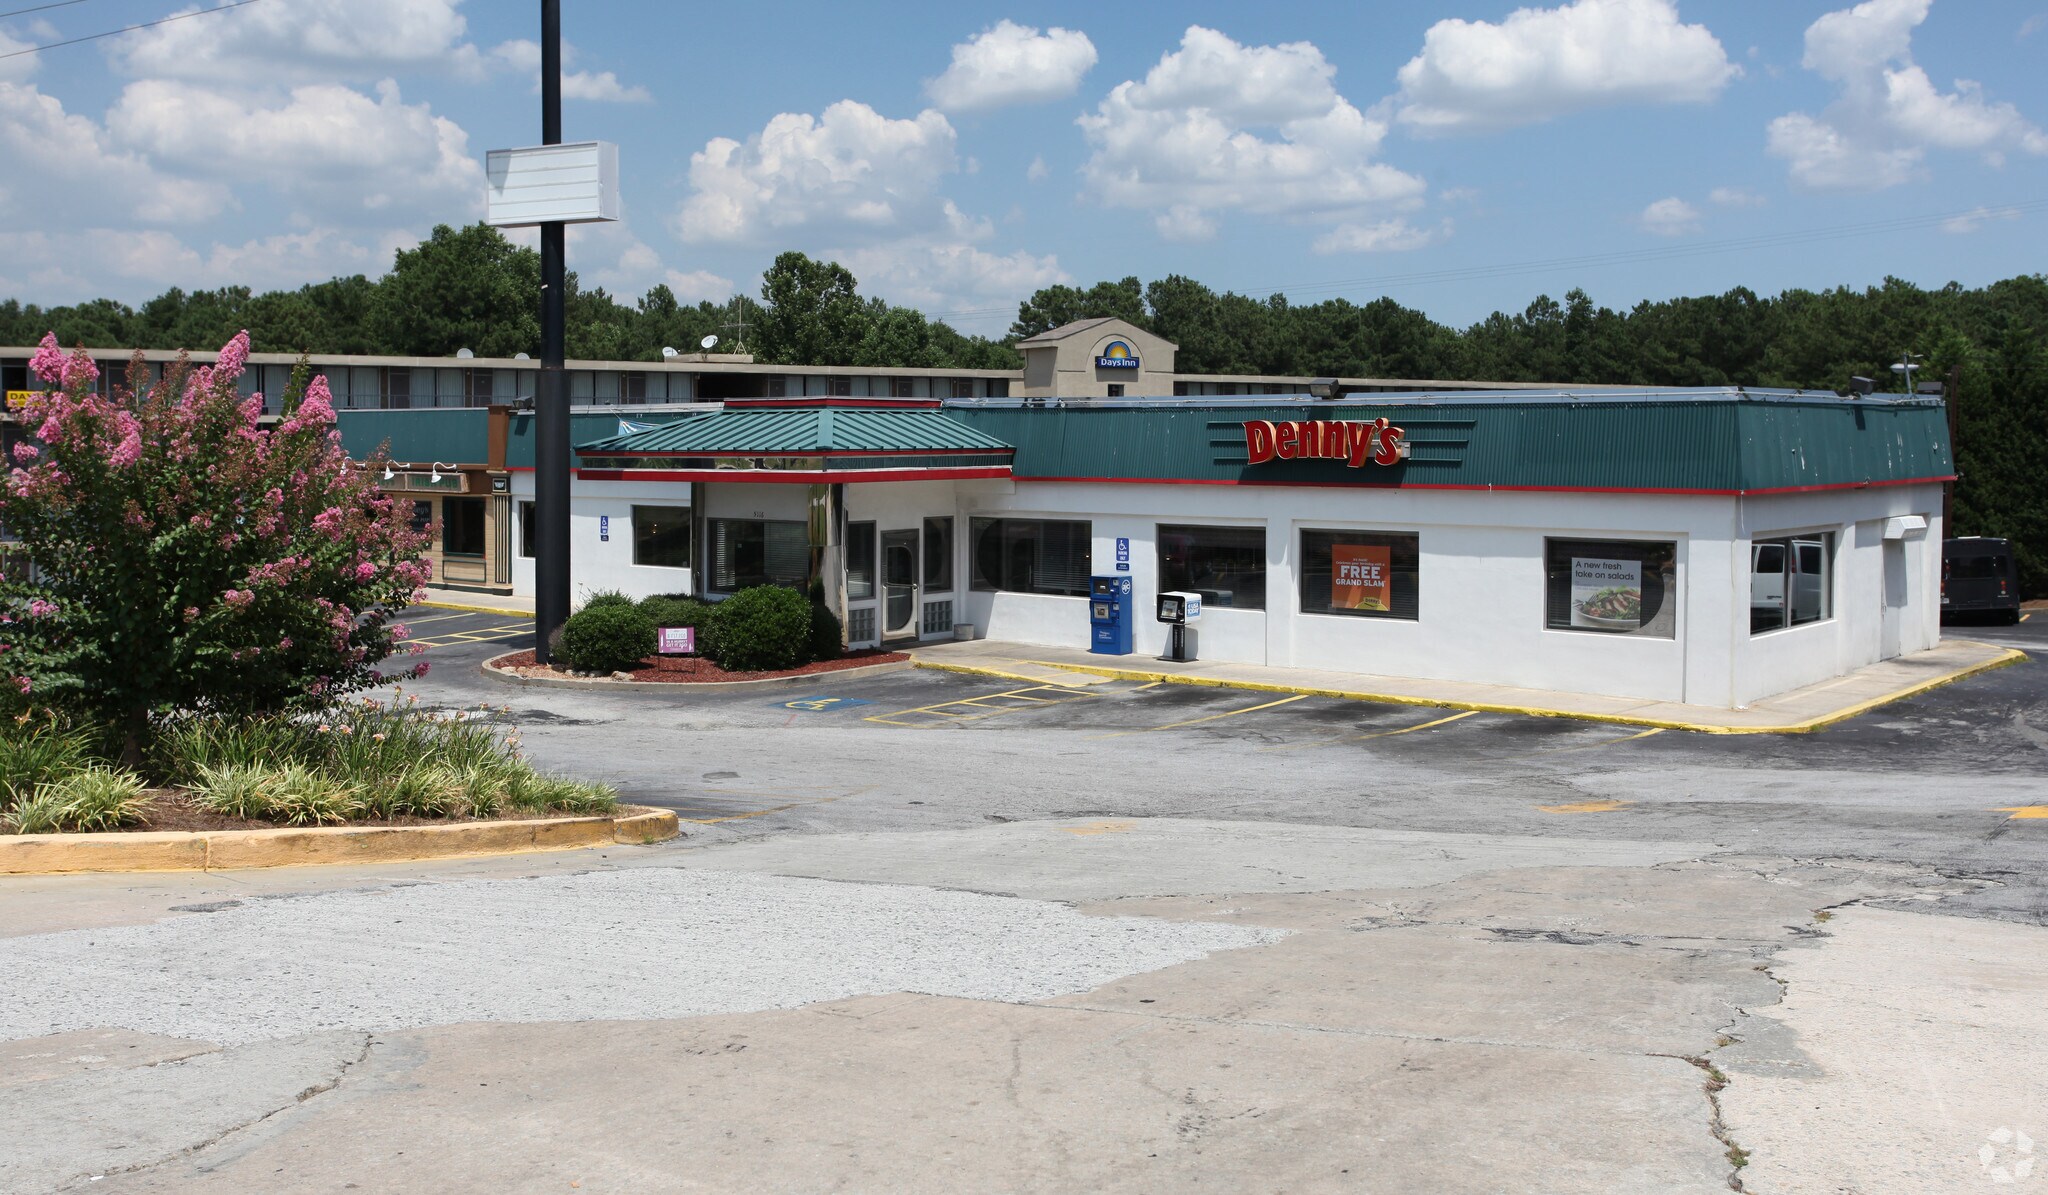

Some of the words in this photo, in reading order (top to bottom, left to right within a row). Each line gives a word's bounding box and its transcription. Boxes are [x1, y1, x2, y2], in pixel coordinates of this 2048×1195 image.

[1100, 358, 1121, 367] Days
[1122, 359, 1136, 367] Inn
[1242, 417, 1405, 468] Denny's
[1575, 560, 1582, 568] A
[1602, 561, 1622, 570] fresh
[1340, 565, 1381, 580] FREE
[1575, 570, 1593, 578] take
[1607, 573, 1635, 581] salads
[1335, 578, 1362, 586] GRAND
[1364, 580, 1385, 588] SLAM
